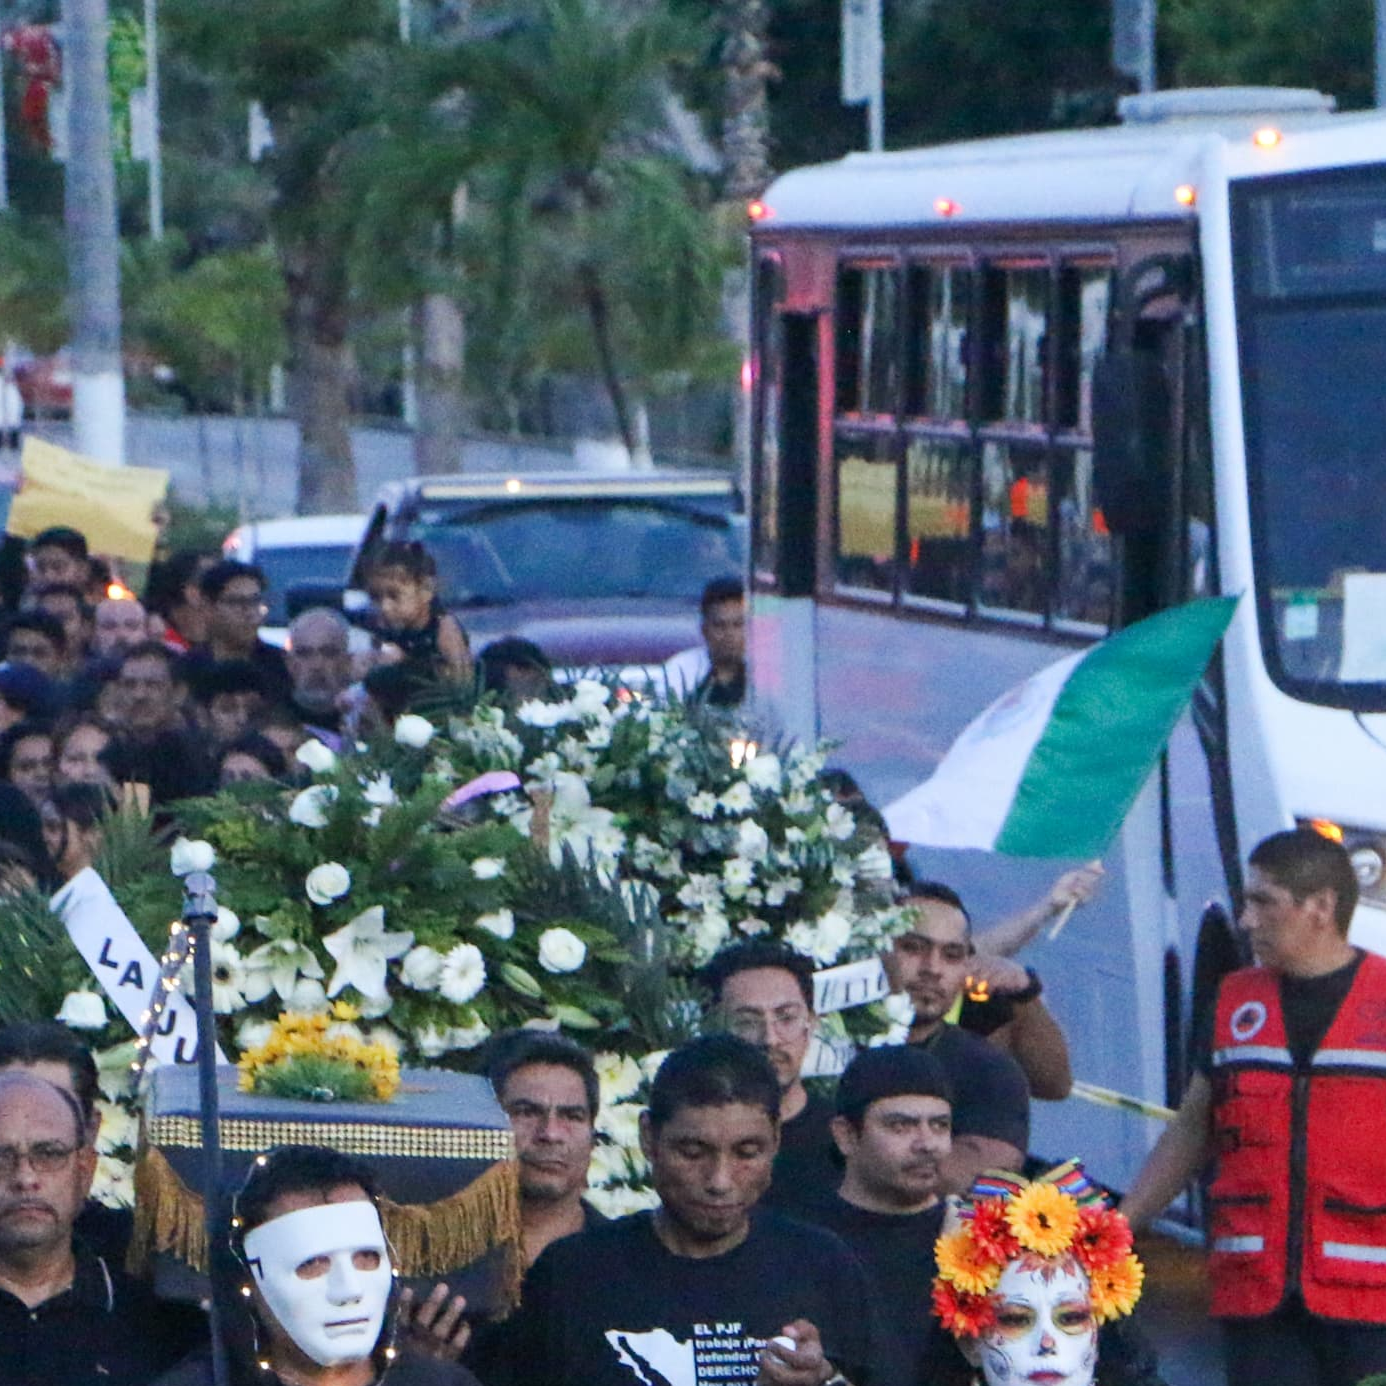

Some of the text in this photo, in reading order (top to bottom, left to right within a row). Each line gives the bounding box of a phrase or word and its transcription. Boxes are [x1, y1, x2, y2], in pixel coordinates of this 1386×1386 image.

[99, 937, 144, 990] LA
[693, 1322, 742, 1335] EL PJF
[695, 1338, 740, 1350] trabaja
[696, 1351, 752, 1363] defender
